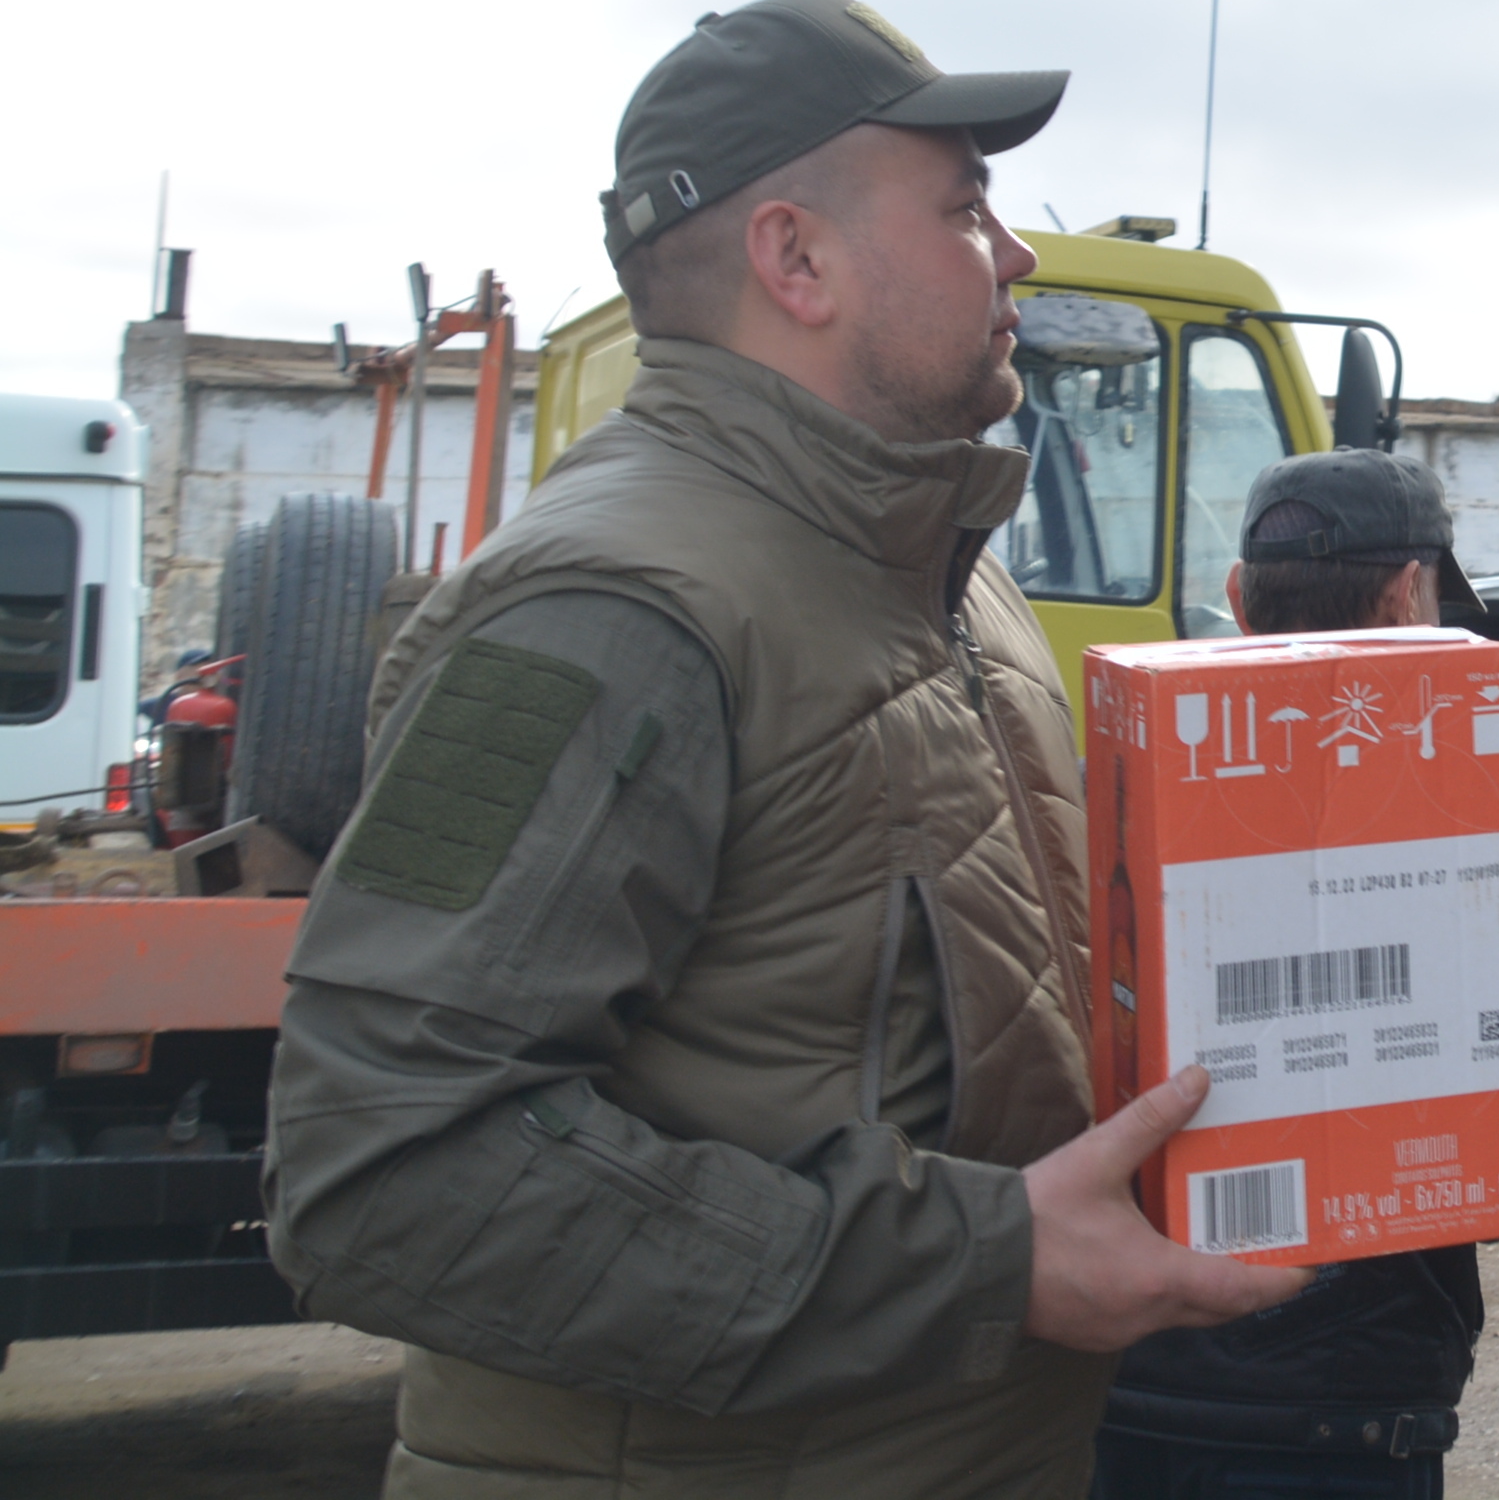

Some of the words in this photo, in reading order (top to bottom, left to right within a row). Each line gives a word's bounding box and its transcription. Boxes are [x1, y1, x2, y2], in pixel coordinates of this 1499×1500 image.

[1322, 1192, 1374, 1225] 14.9%
[1376, 1188, 1402, 1216] vol
[1414, 1180, 1462, 1212] 6x750
[1466, 1176, 1486, 1204] ml
